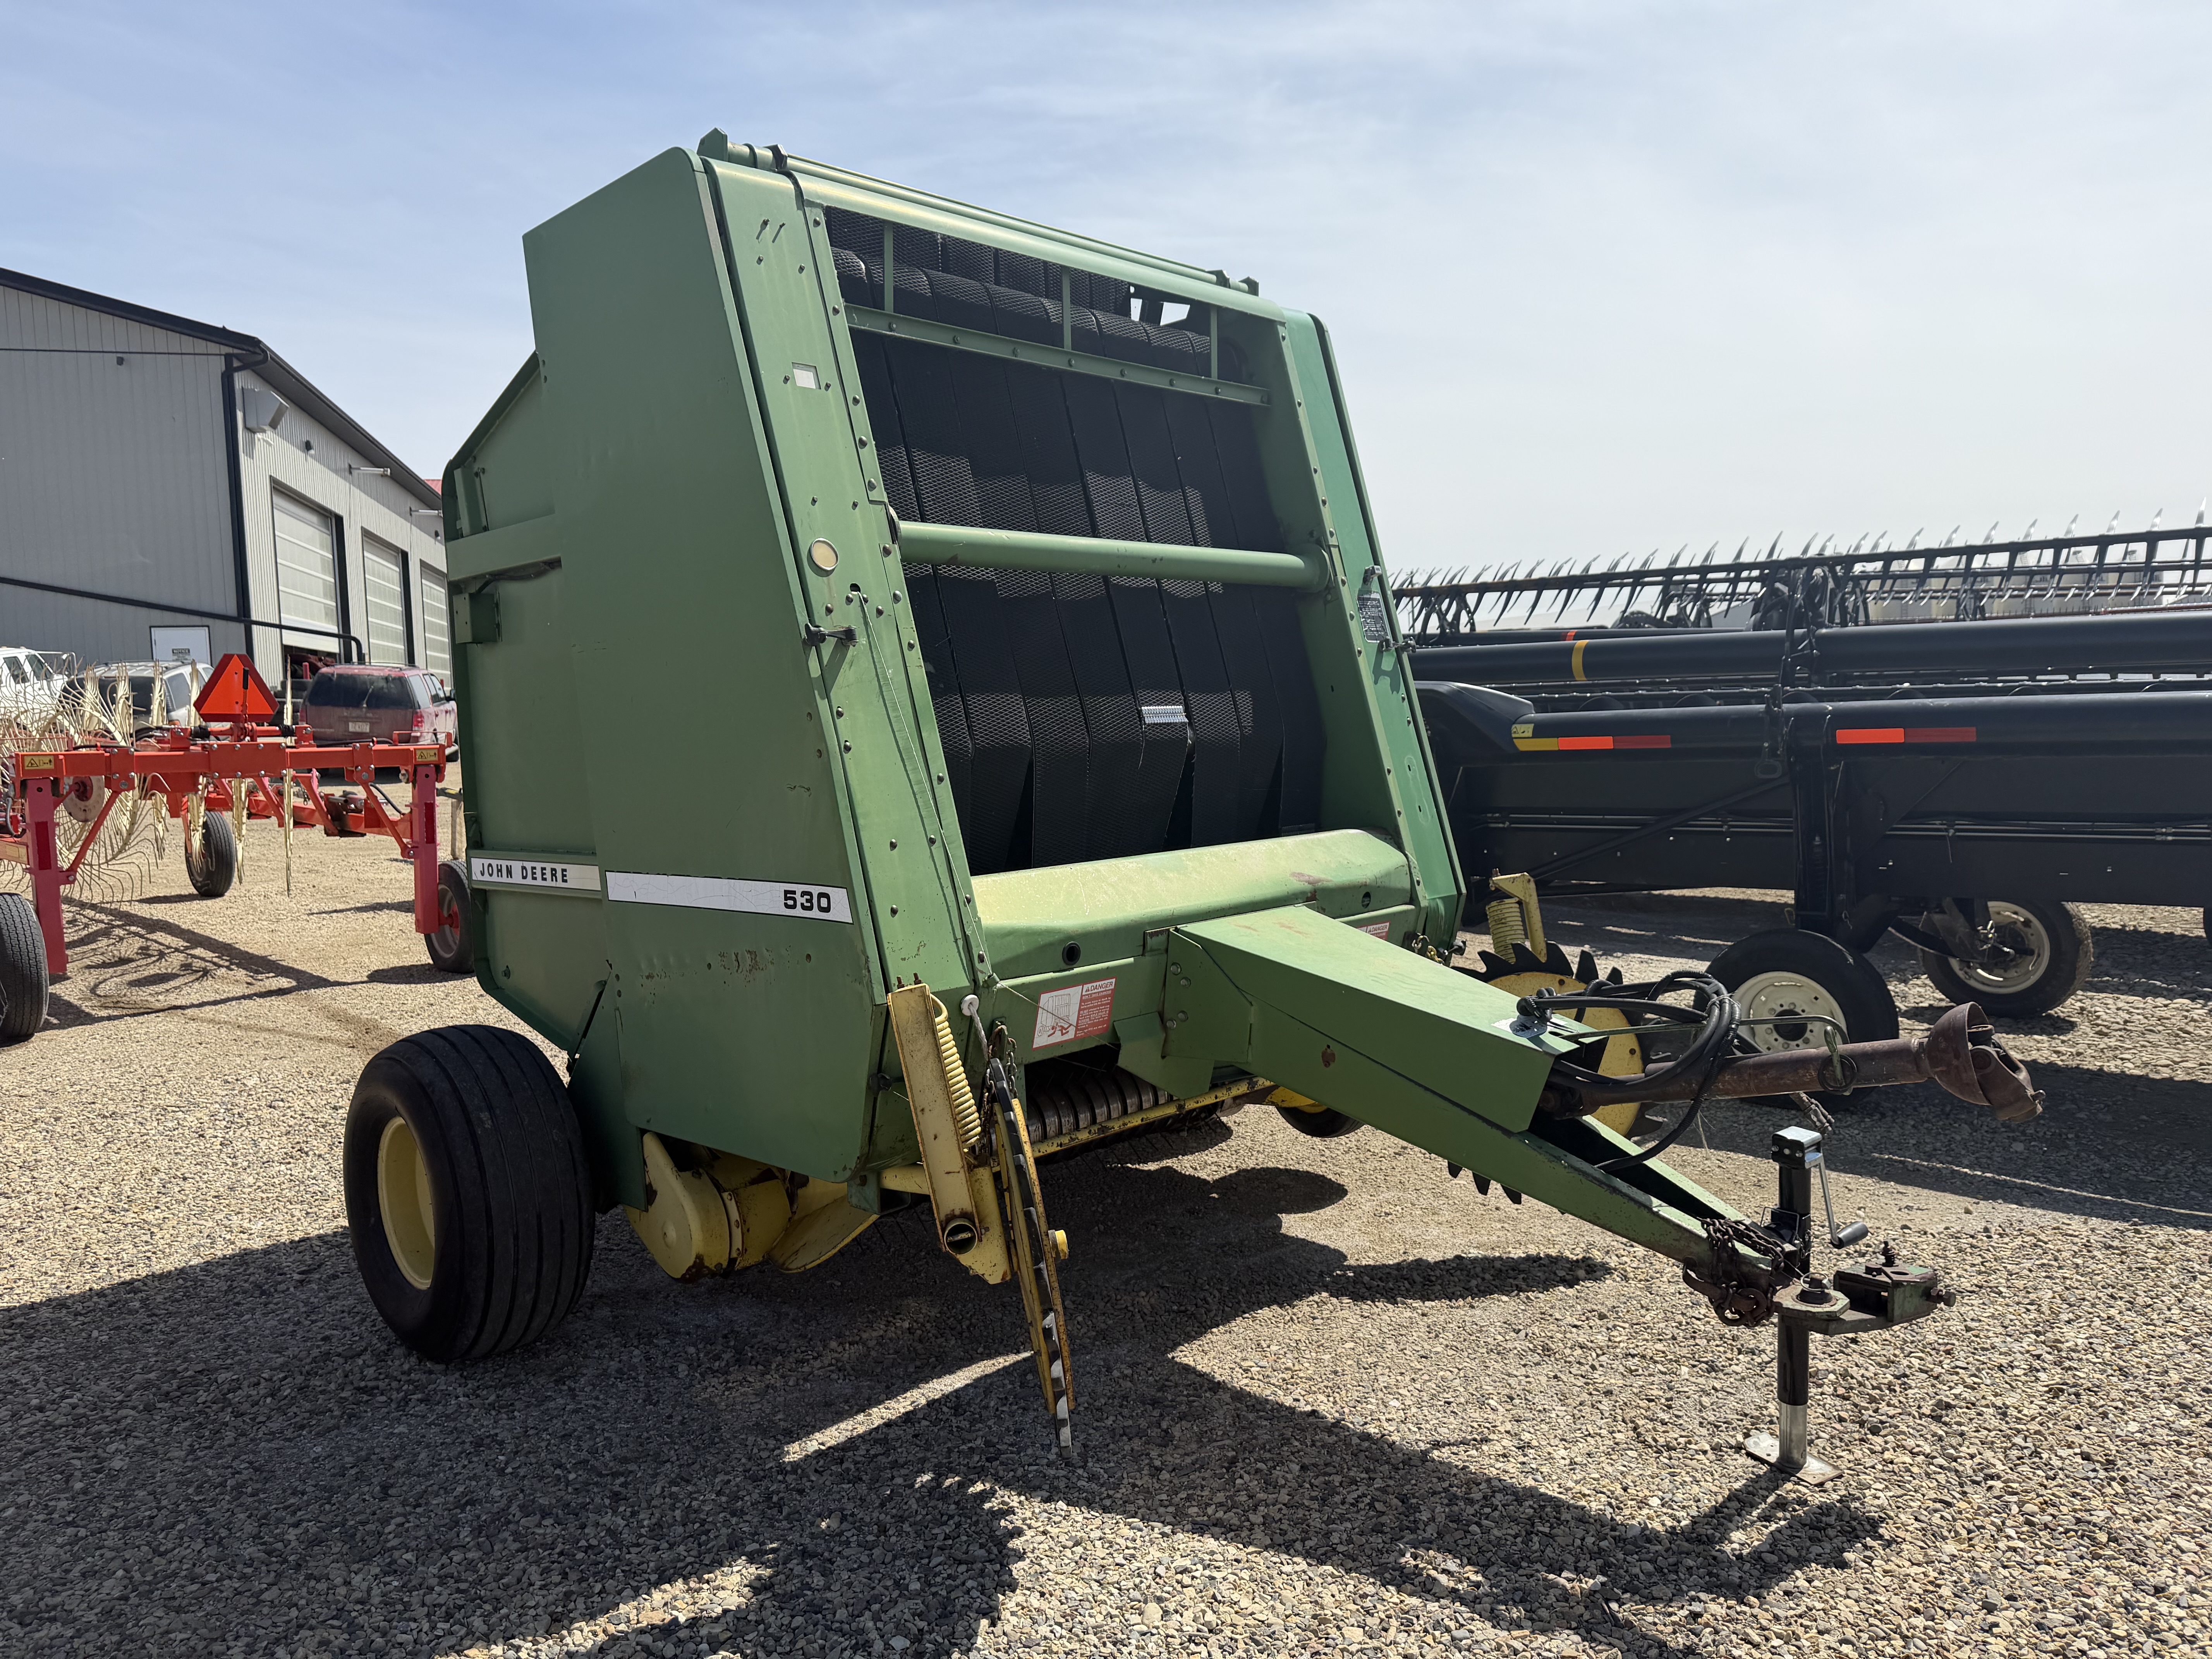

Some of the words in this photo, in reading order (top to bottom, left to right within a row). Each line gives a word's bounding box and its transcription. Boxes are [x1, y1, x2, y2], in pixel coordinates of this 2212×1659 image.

[480, 863, 513, 879] JOHN
[521, 866, 568, 883] DEERE
[783, 889, 831, 913] 530
[1090, 981, 1113, 992] DANGER
